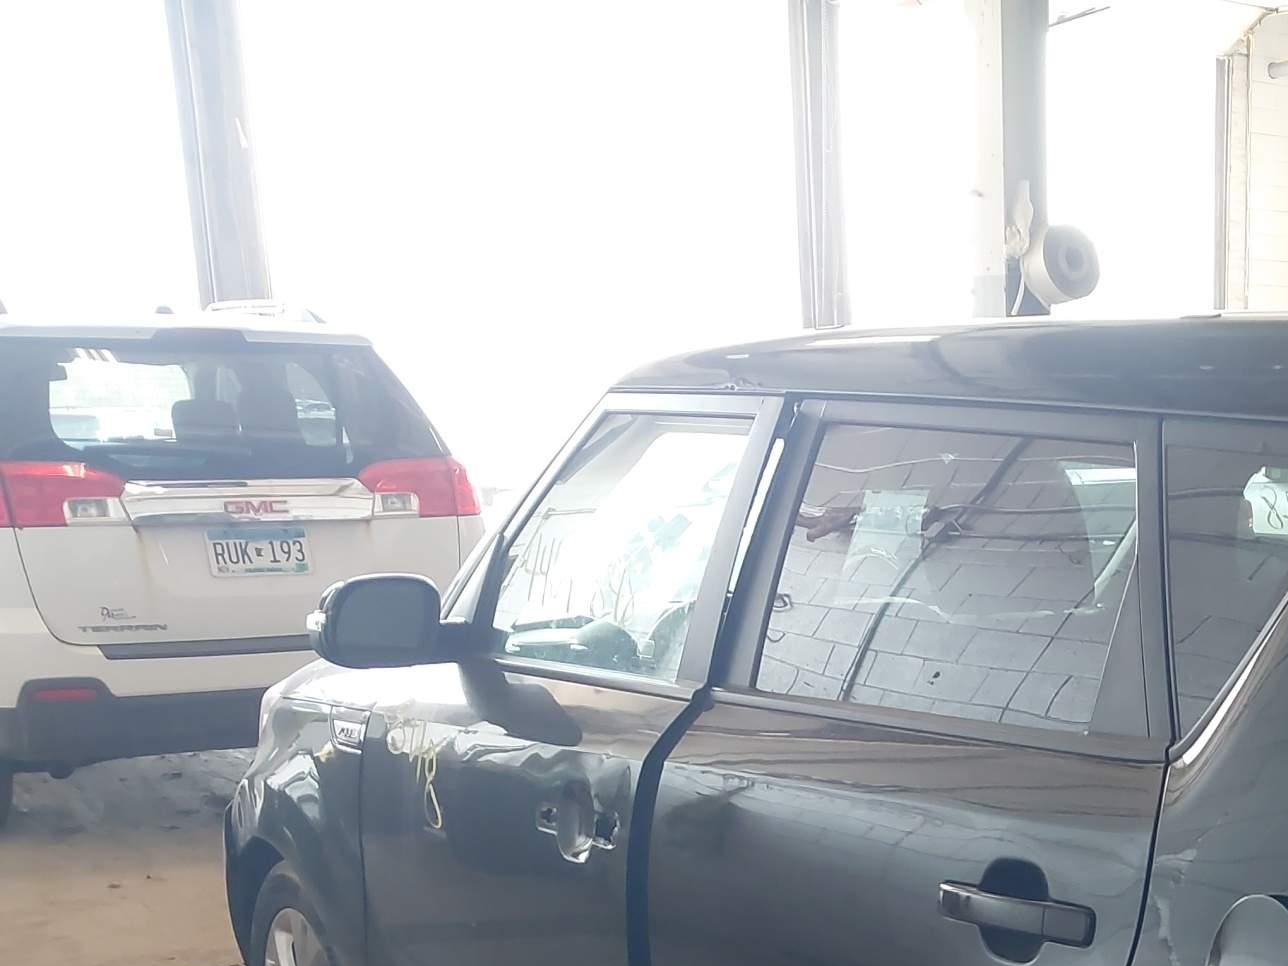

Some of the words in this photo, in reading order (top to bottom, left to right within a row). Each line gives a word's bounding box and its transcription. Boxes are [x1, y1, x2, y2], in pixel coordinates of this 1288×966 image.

[223, 500, 289, 514] GMC
[212, 541, 254, 566] RUK
[268, 540, 306, 563] 193
